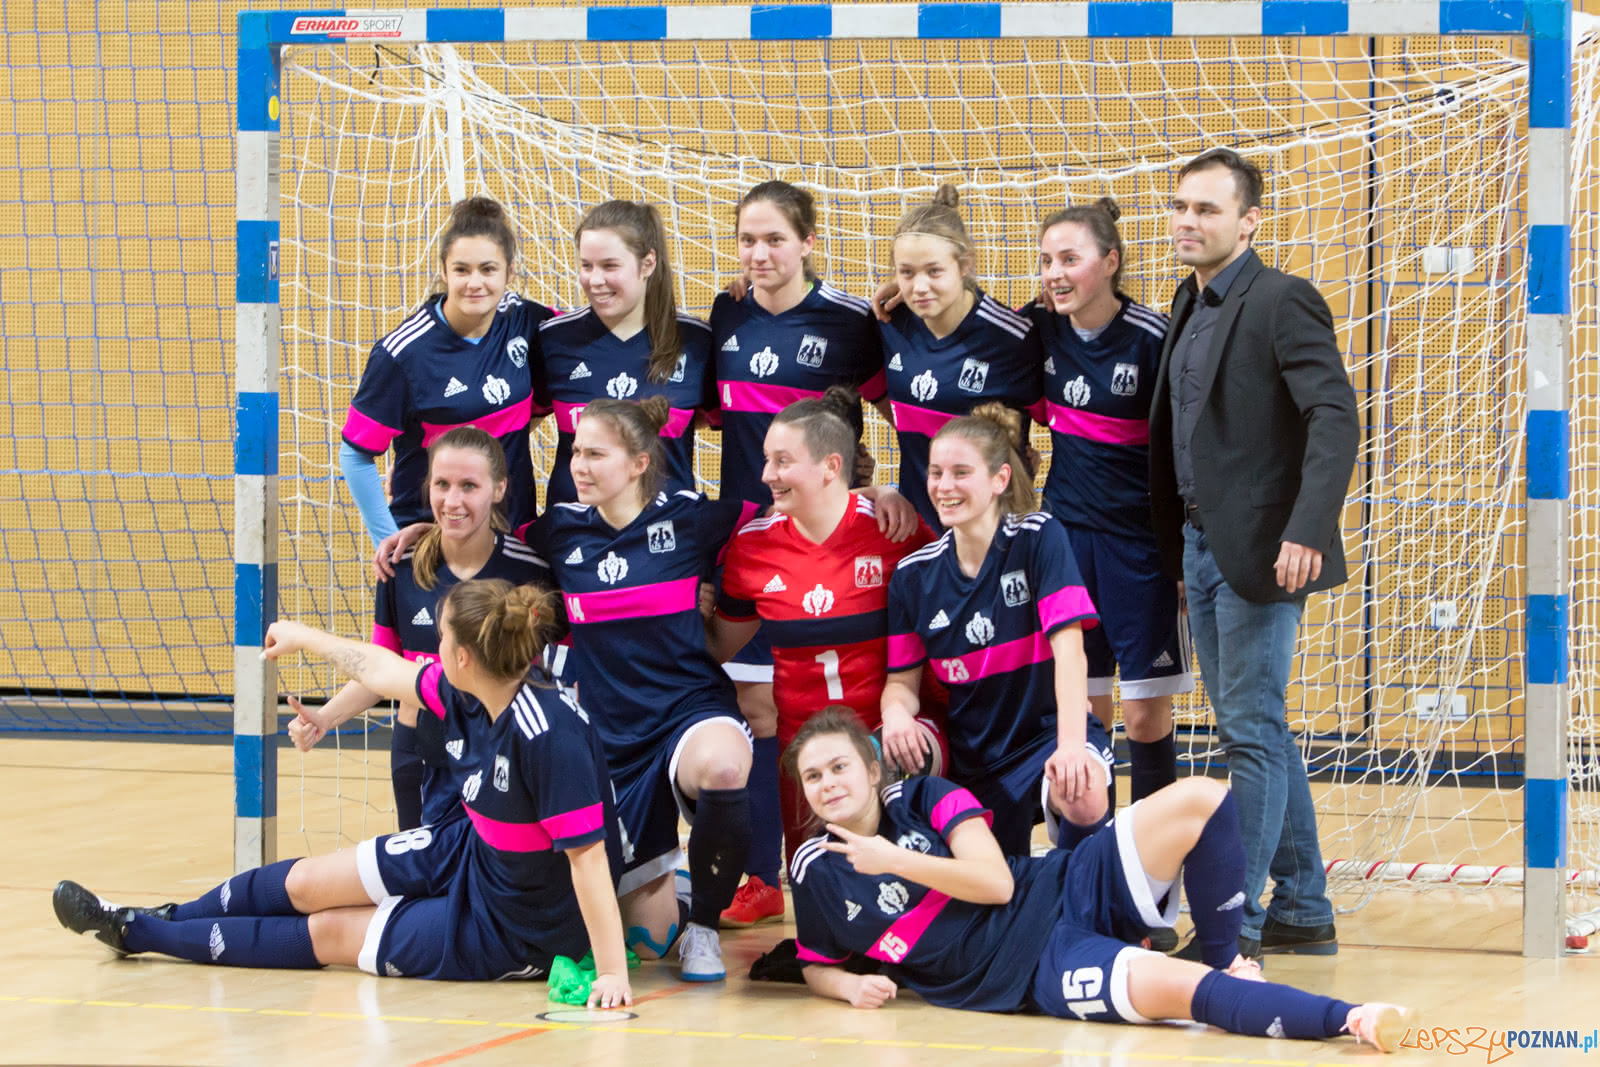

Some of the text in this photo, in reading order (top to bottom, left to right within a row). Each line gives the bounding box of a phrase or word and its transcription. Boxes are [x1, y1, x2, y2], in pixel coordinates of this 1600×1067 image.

[295, 19, 397, 31] ERHARD SPORT
[815, 649, 844, 700] 1
[941, 657, 971, 682] 23
[879, 932, 908, 962] 15
[1062, 966, 1107, 1021] 15
